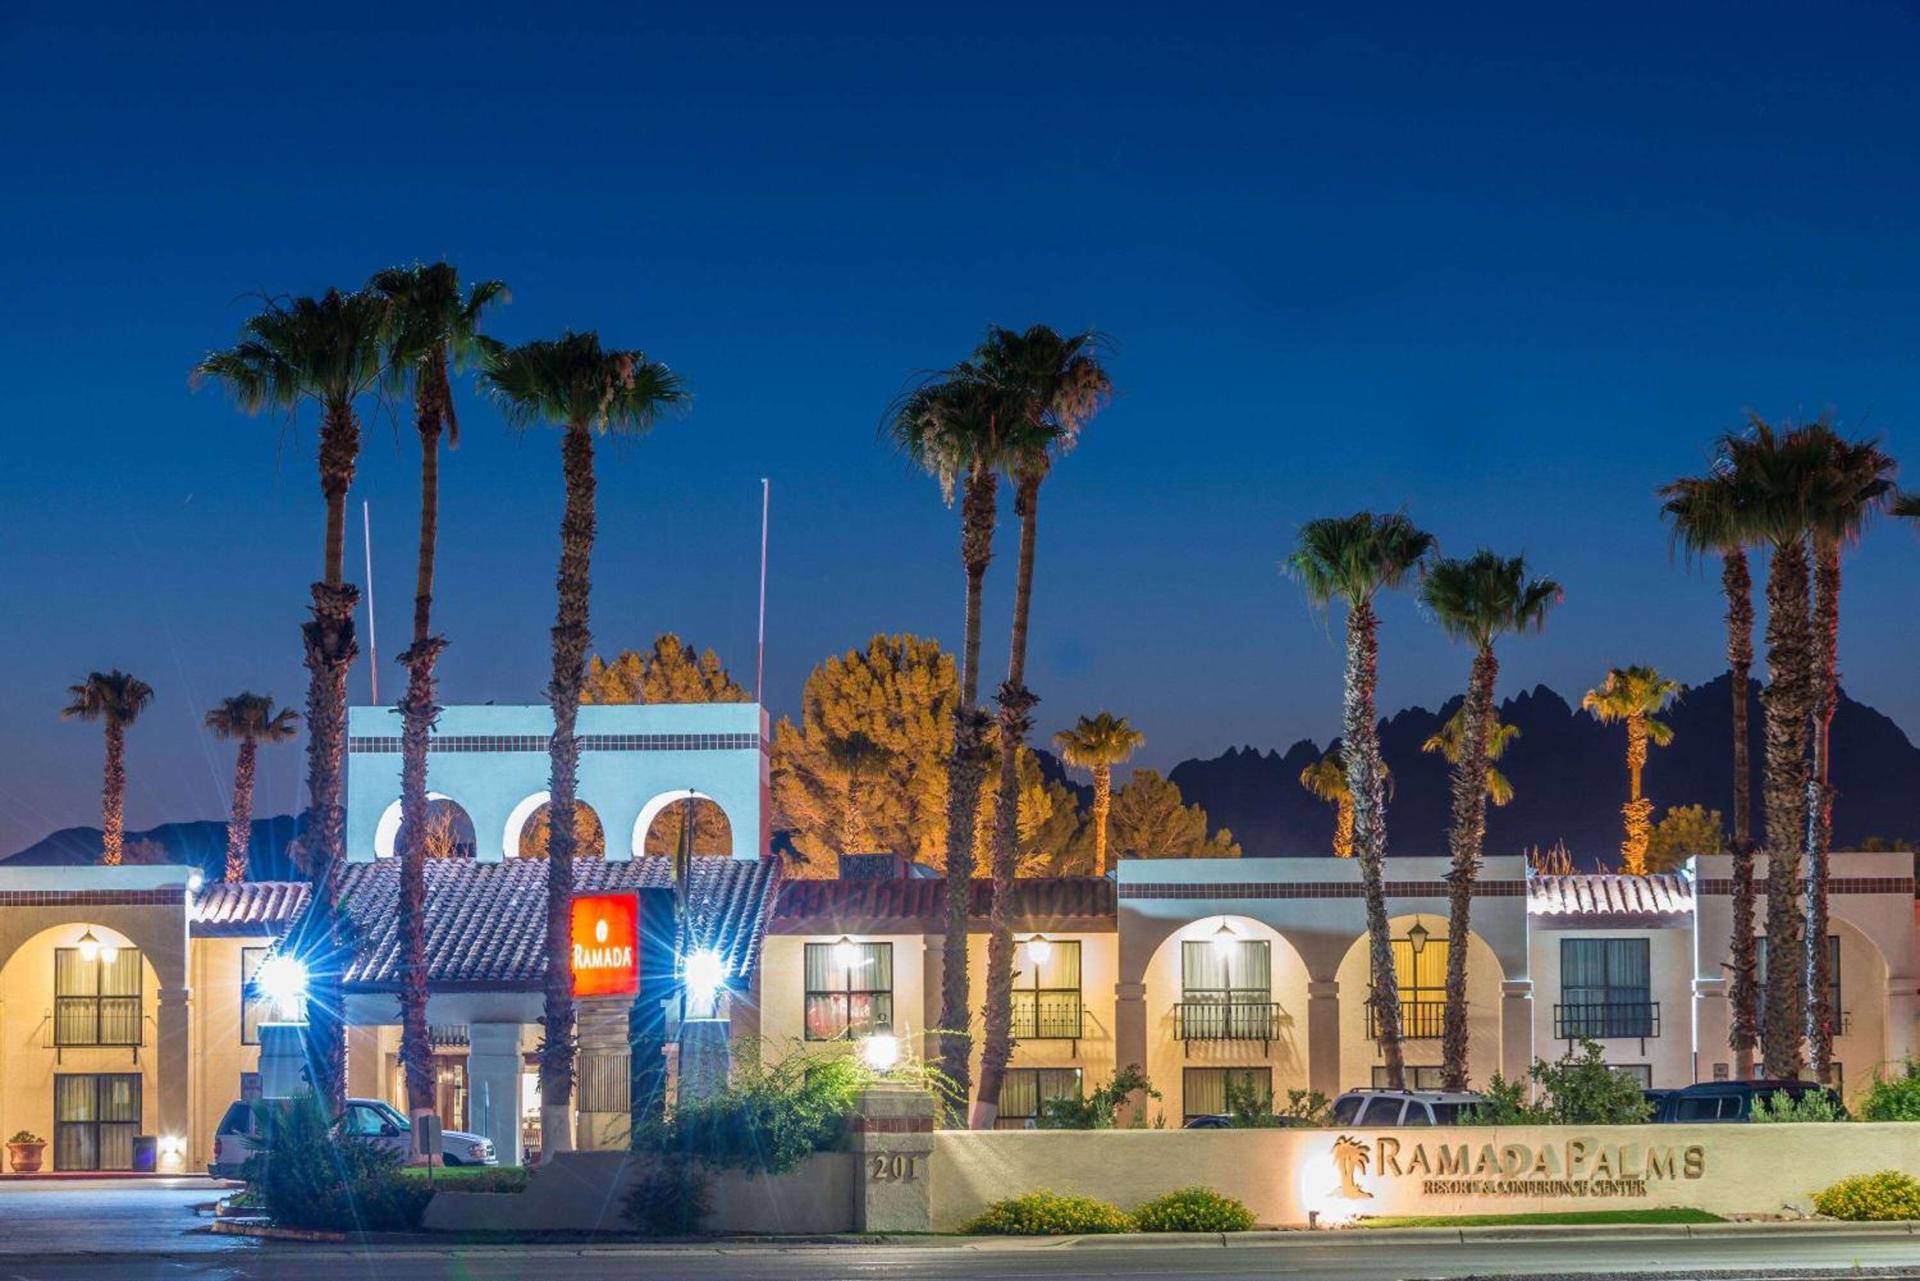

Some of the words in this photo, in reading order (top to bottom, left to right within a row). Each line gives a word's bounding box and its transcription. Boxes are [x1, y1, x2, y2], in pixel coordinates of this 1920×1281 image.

[574, 944, 632, 969] RAMADA
[873, 1154, 920, 1181] 201
[1376, 1136, 1561, 1179] RAMADA
[1566, 1136, 1705, 1180] PALMS
[1424, 1180, 1481, 1194] RESORT
[1482, 1180, 1496, 1195] &
[1496, 1180, 1588, 1197] CONFERENCE
[1590, 1180, 1647, 1197] CENTER
